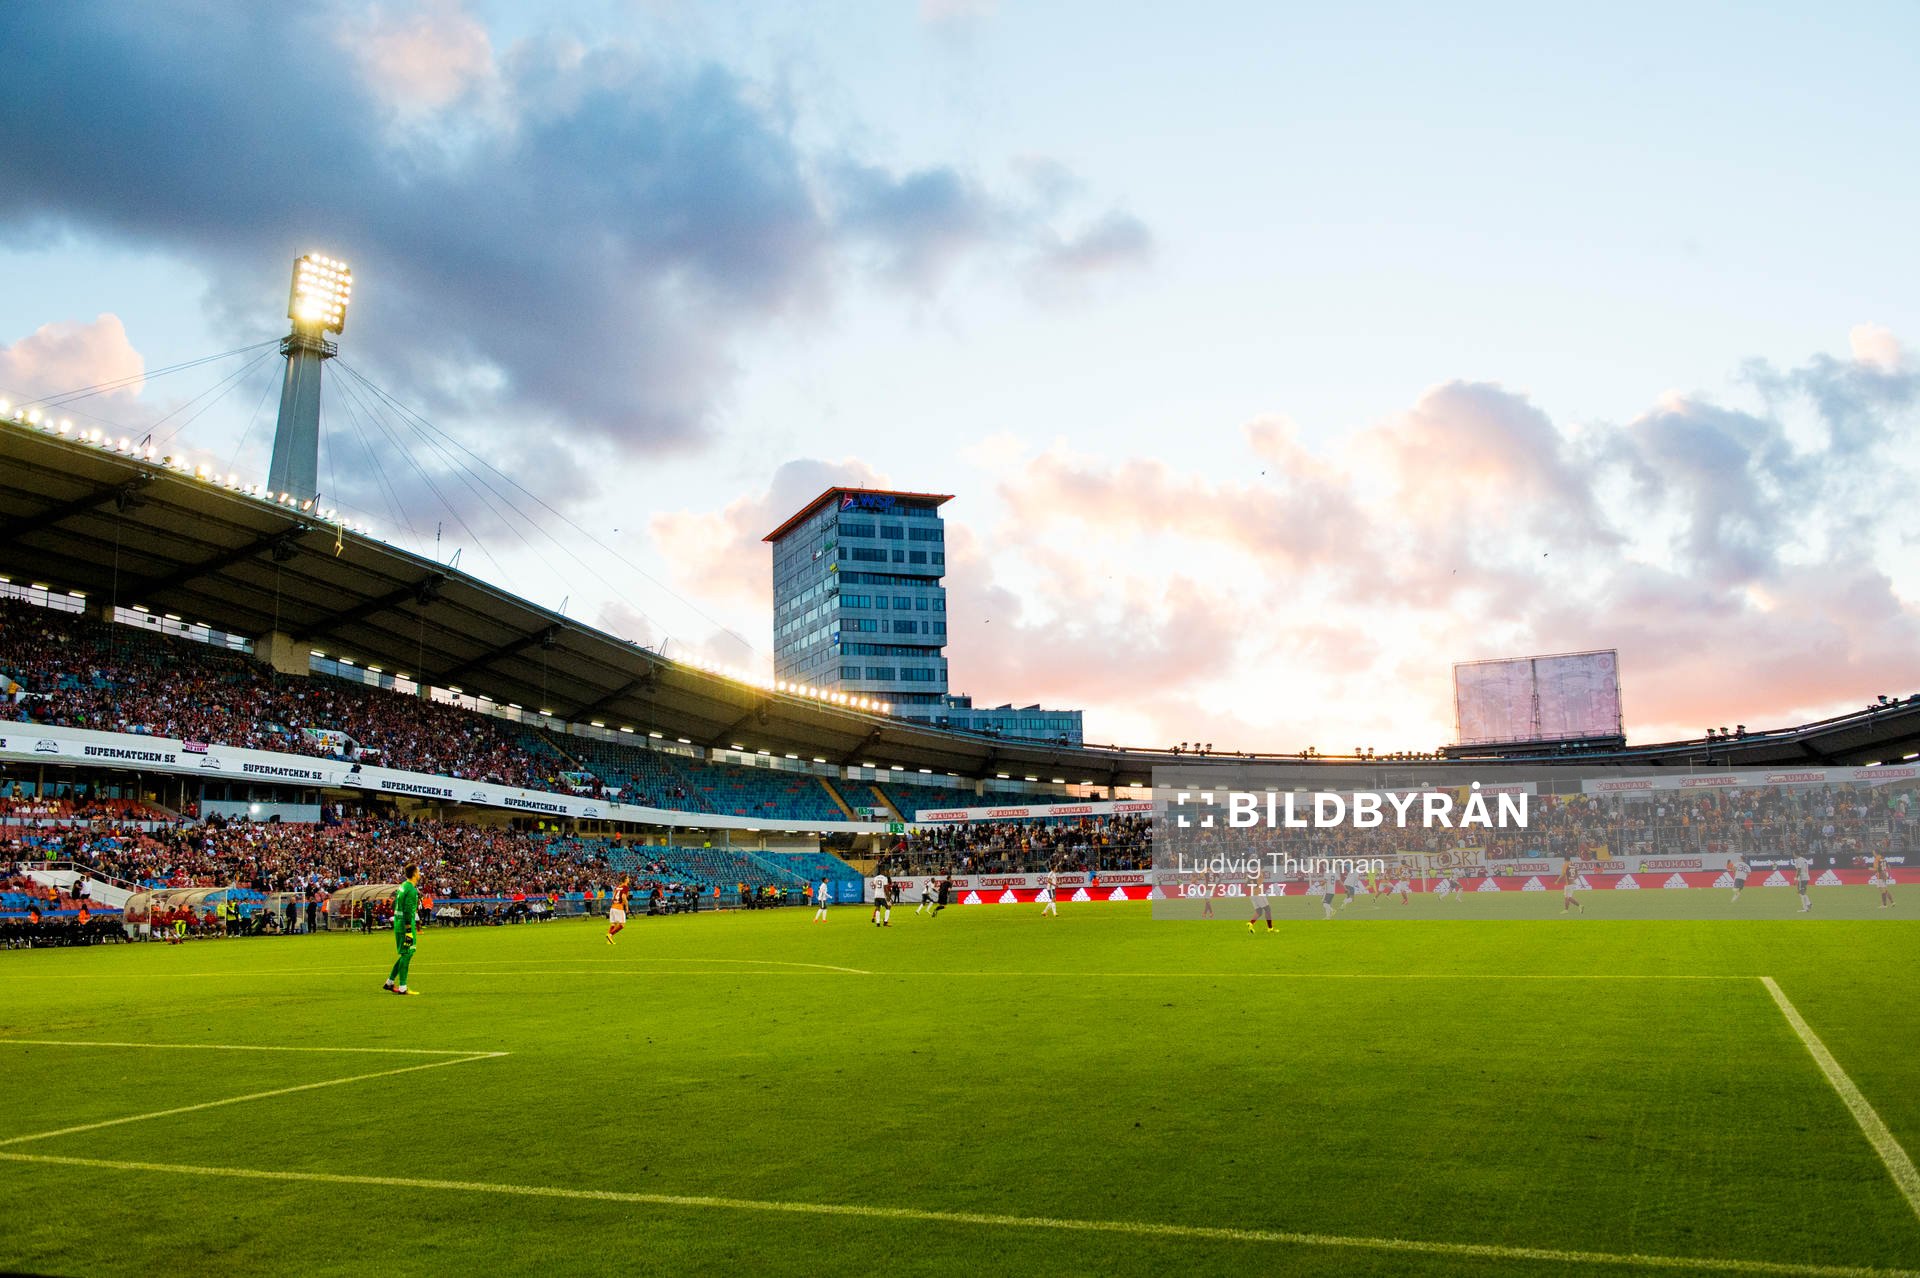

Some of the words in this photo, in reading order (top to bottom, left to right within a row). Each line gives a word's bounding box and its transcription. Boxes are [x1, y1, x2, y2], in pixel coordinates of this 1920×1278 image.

[859, 494, 896, 510] WSP
[84, 746, 176, 763] SUPERMATCHEN.SE
[1863, 768, 1915, 778] BAUHAUS
[381, 781, 453, 797] SUPERMATCHEN.SE
[1605, 781, 1652, 790] BAUHAUS
[1649, 859, 1702, 868] BAUHAUS
[1103, 875, 1144, 883] BAUHAUS
